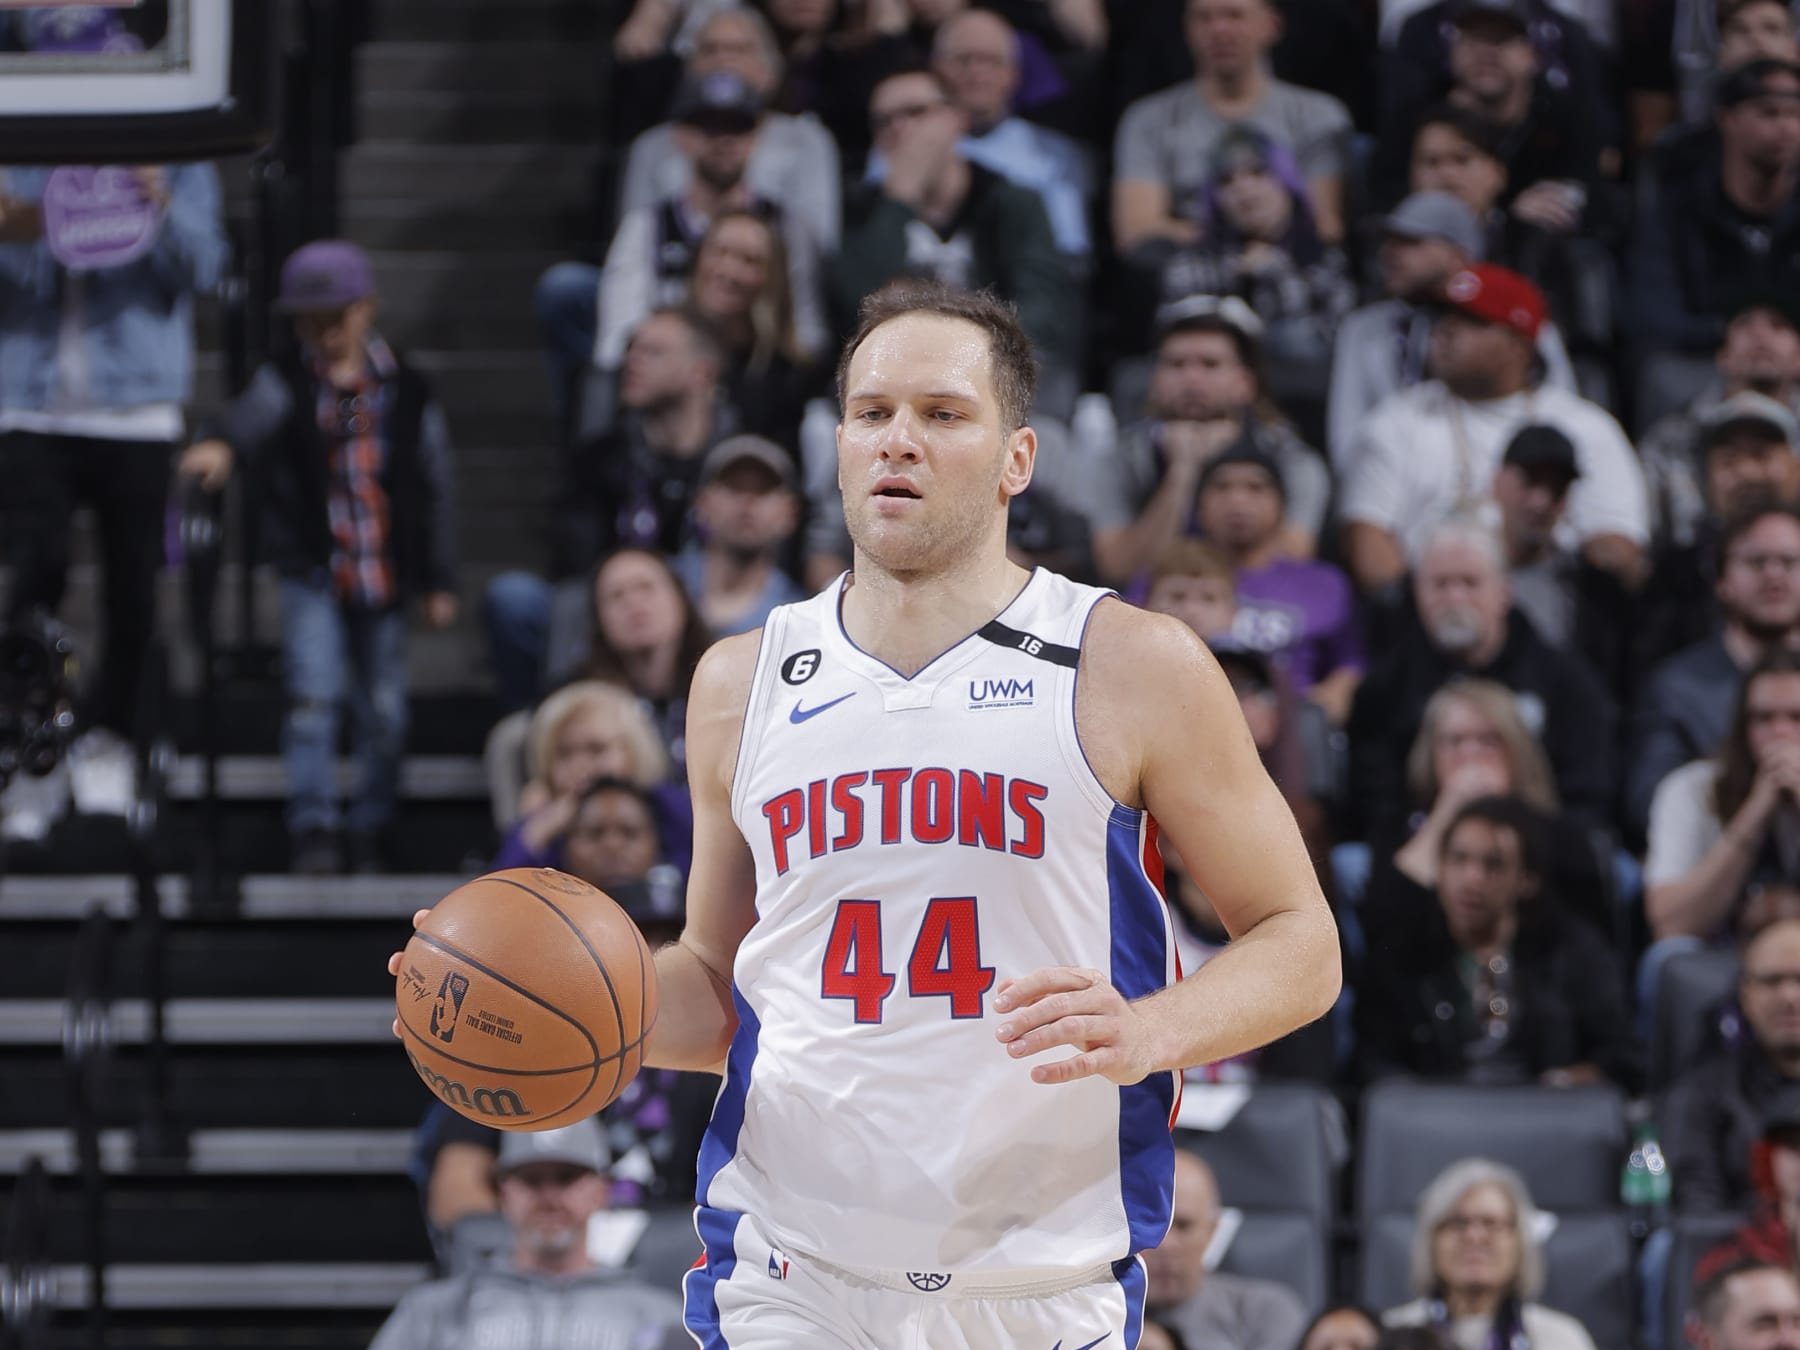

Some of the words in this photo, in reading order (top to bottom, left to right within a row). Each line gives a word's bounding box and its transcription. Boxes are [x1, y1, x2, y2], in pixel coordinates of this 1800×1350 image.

[1018, 635, 1043, 655] 16
[789, 653, 816, 682] 6
[970, 679, 1033, 702] UWM
[762, 767, 1049, 877] PISTONS
[821, 896, 996, 1024] 44
